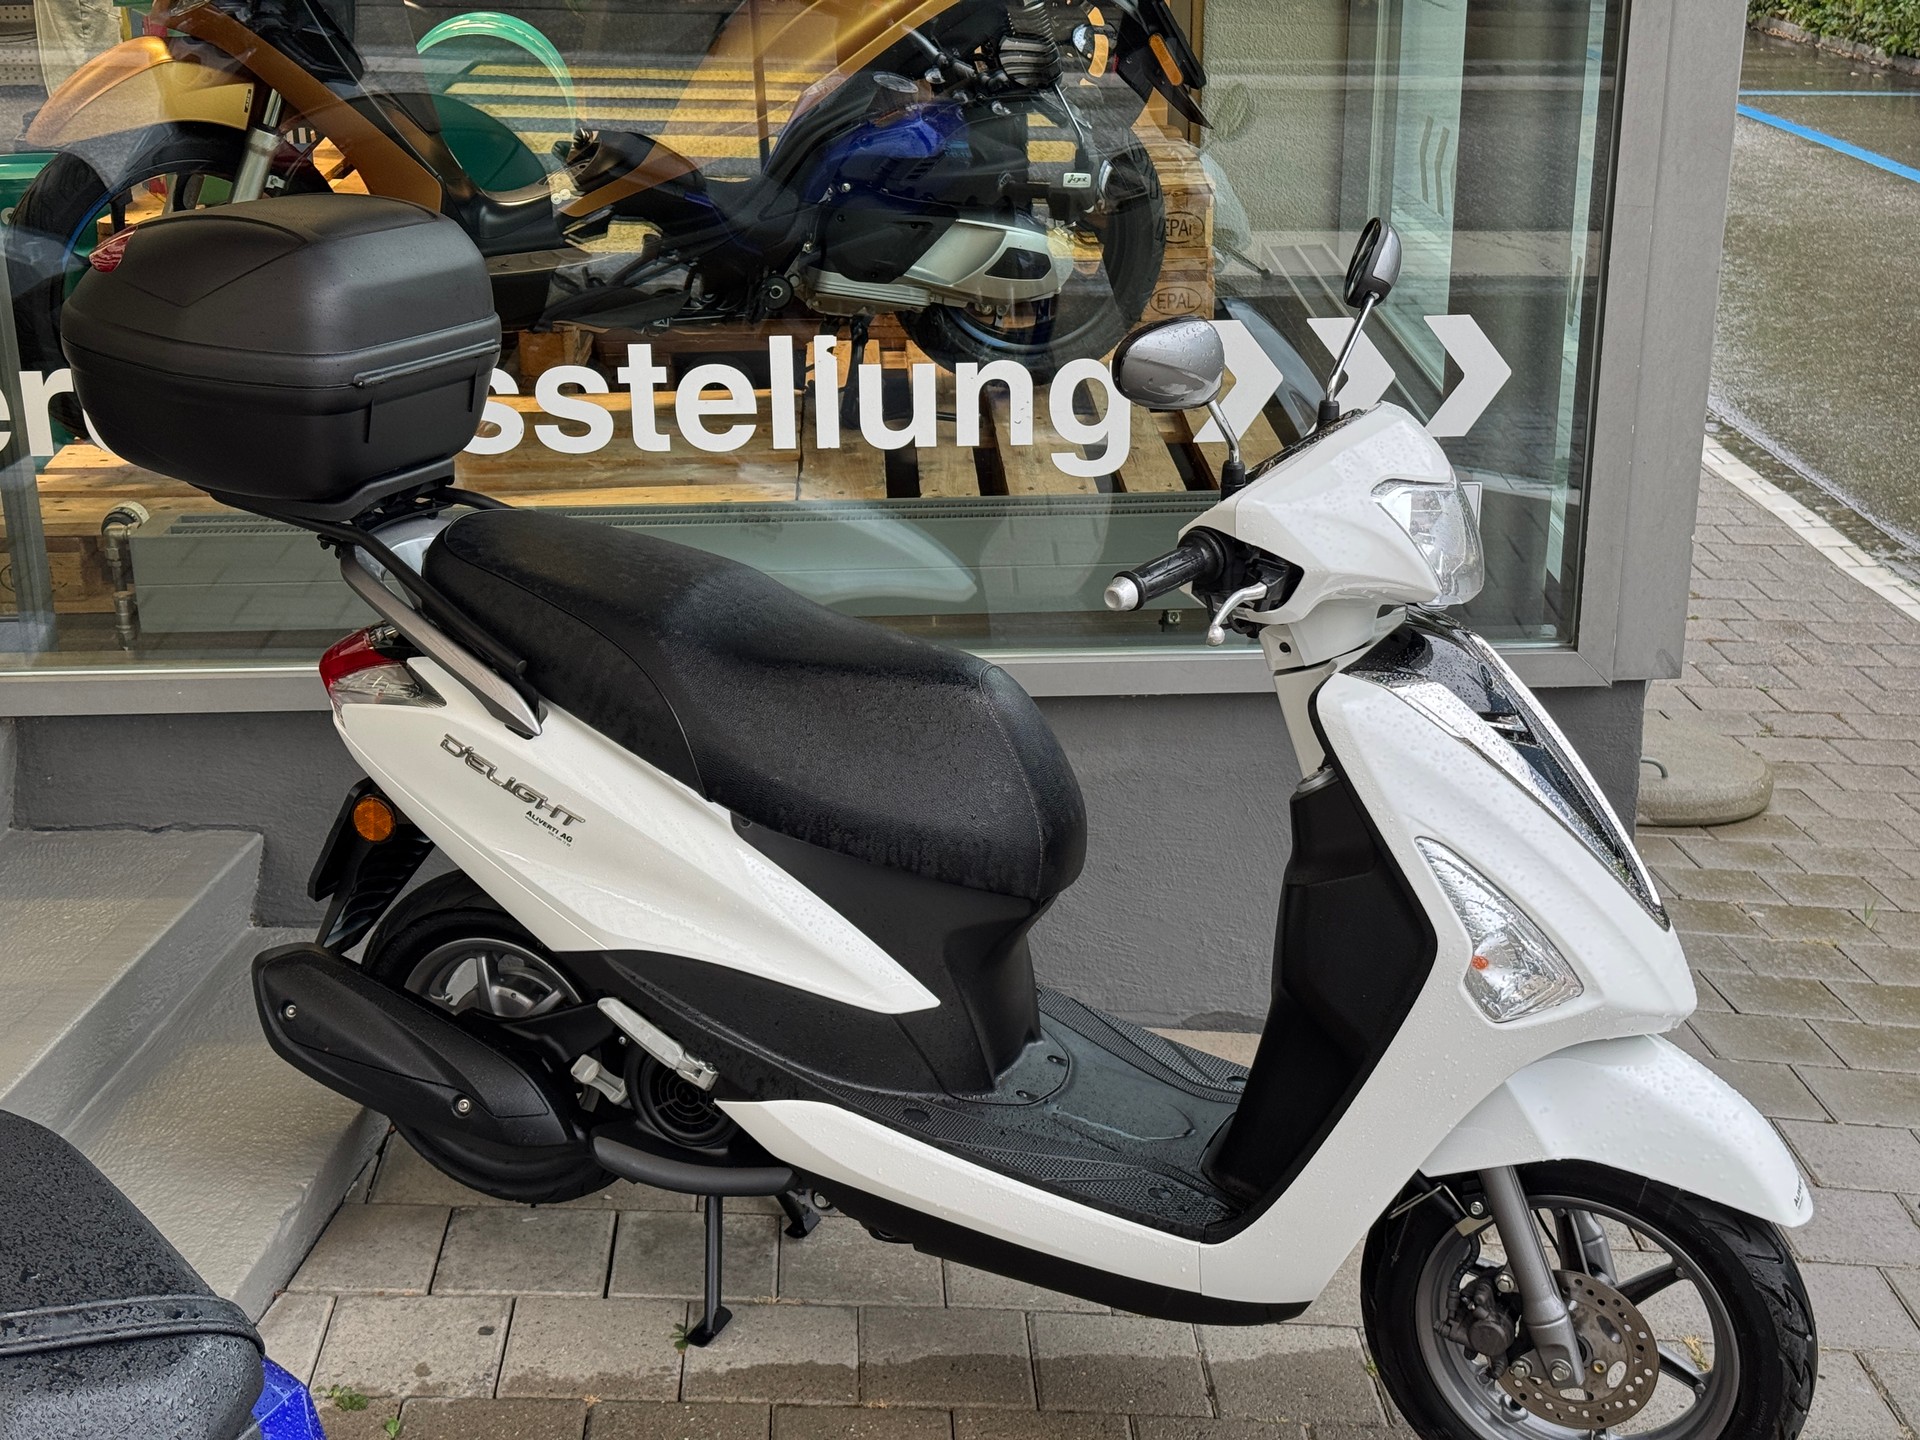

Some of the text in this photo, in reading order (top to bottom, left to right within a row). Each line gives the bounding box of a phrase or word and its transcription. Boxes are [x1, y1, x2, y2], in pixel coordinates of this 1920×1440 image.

[1157, 293, 1195, 309] EPAL
[463, 335, 1131, 477] sstellung
[526, 810, 559, 834] ALIVERTI
[560, 832, 573, 843] AG
